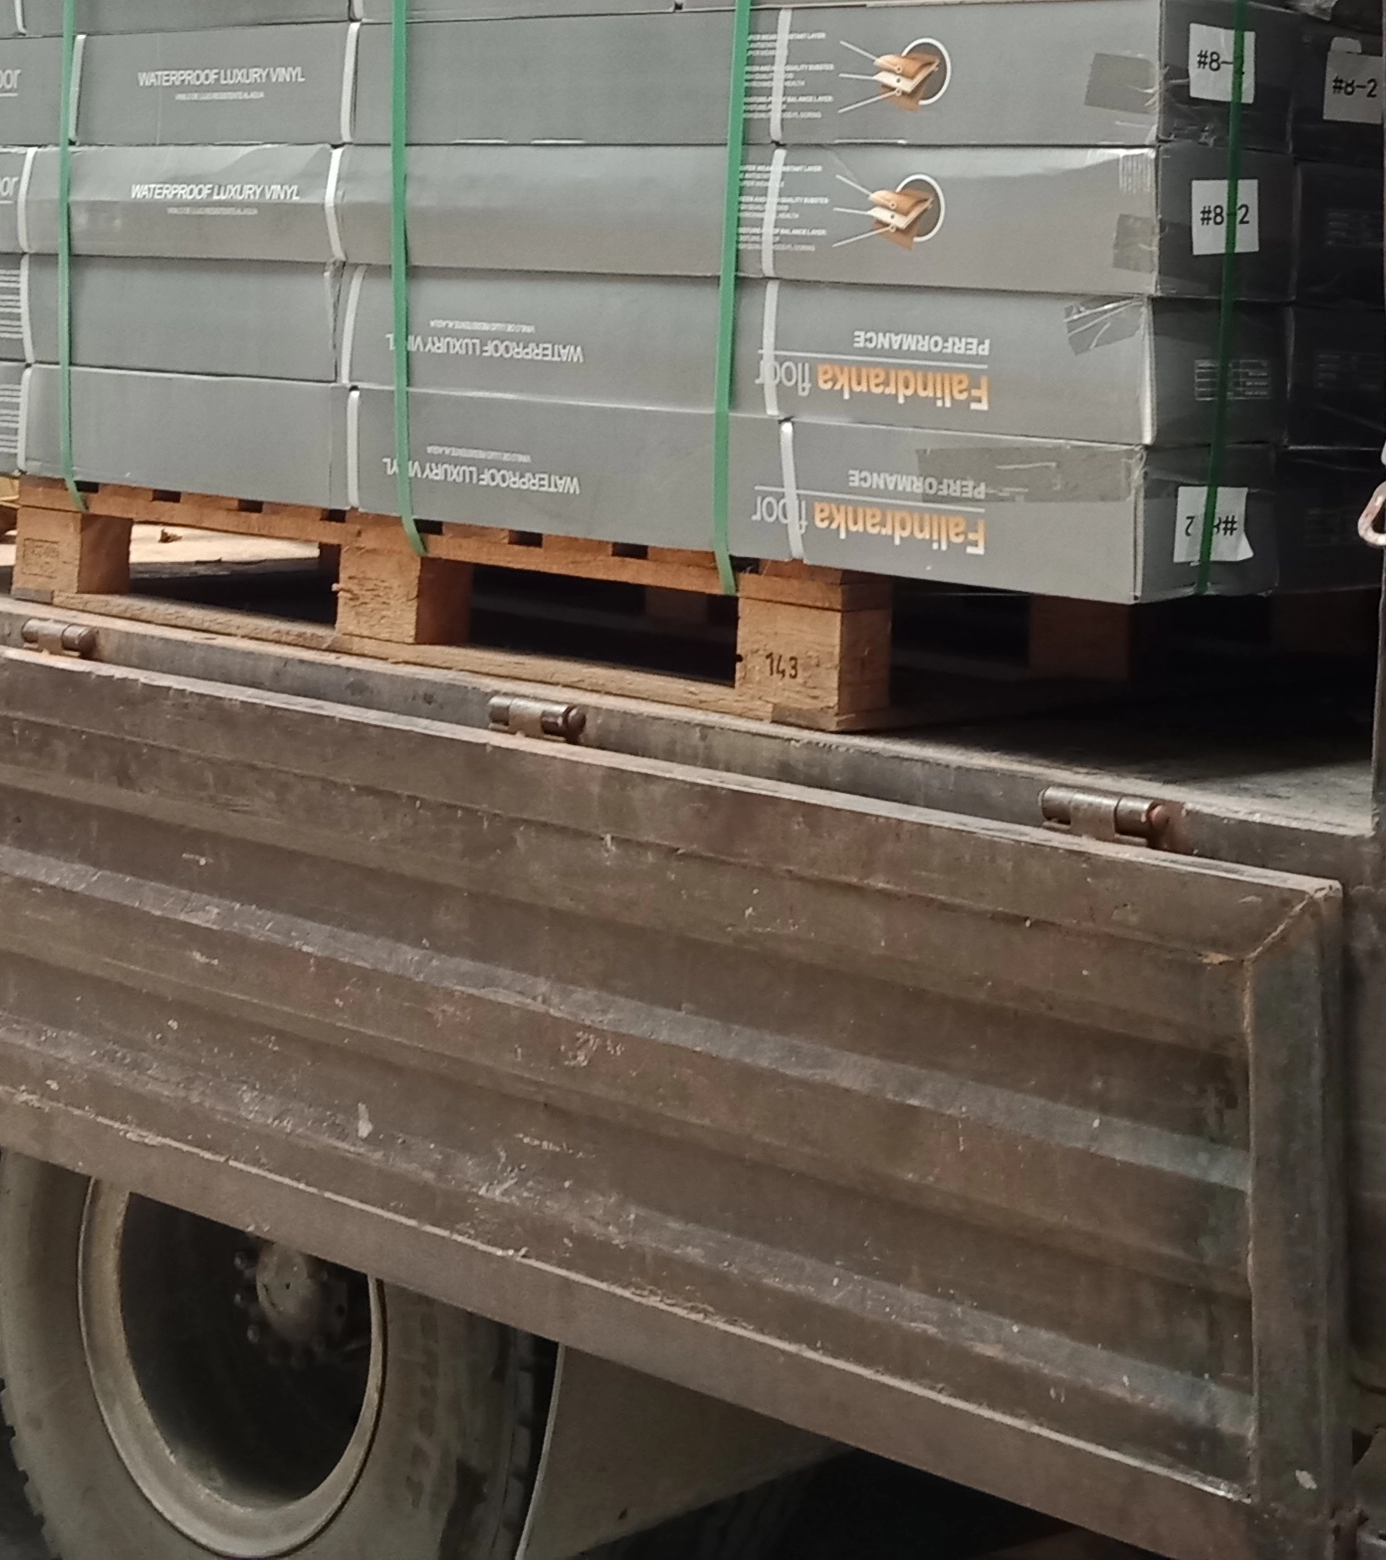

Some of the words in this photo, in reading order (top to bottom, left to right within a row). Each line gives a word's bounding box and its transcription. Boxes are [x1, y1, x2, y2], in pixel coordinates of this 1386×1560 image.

[137, 69, 219, 87] WATERPROOF
[219, 67, 269, 85] LUXURY
[269, 66, 306, 83] VINYL
[130, 183, 212, 200] WATERPROOF
[212, 184, 263, 200] LUXURY
[264, 184, 301, 201] VINYL
[423, 335, 481, 357] LUXURY
[480, 340, 584, 364] WATERPROOF
[853, 330, 991, 356] PERFORMANCE
[817, 362, 989, 411] Falindranka
[422, 460, 479, 484] LUXURY
[478, 466, 580, 495] WATERPROOF
[848, 469, 986, 500] PERFORMANCE
[751, 495, 808, 534] foor
[814, 501, 986, 556] Falindranka
[765, 651, 800, 680] 143
